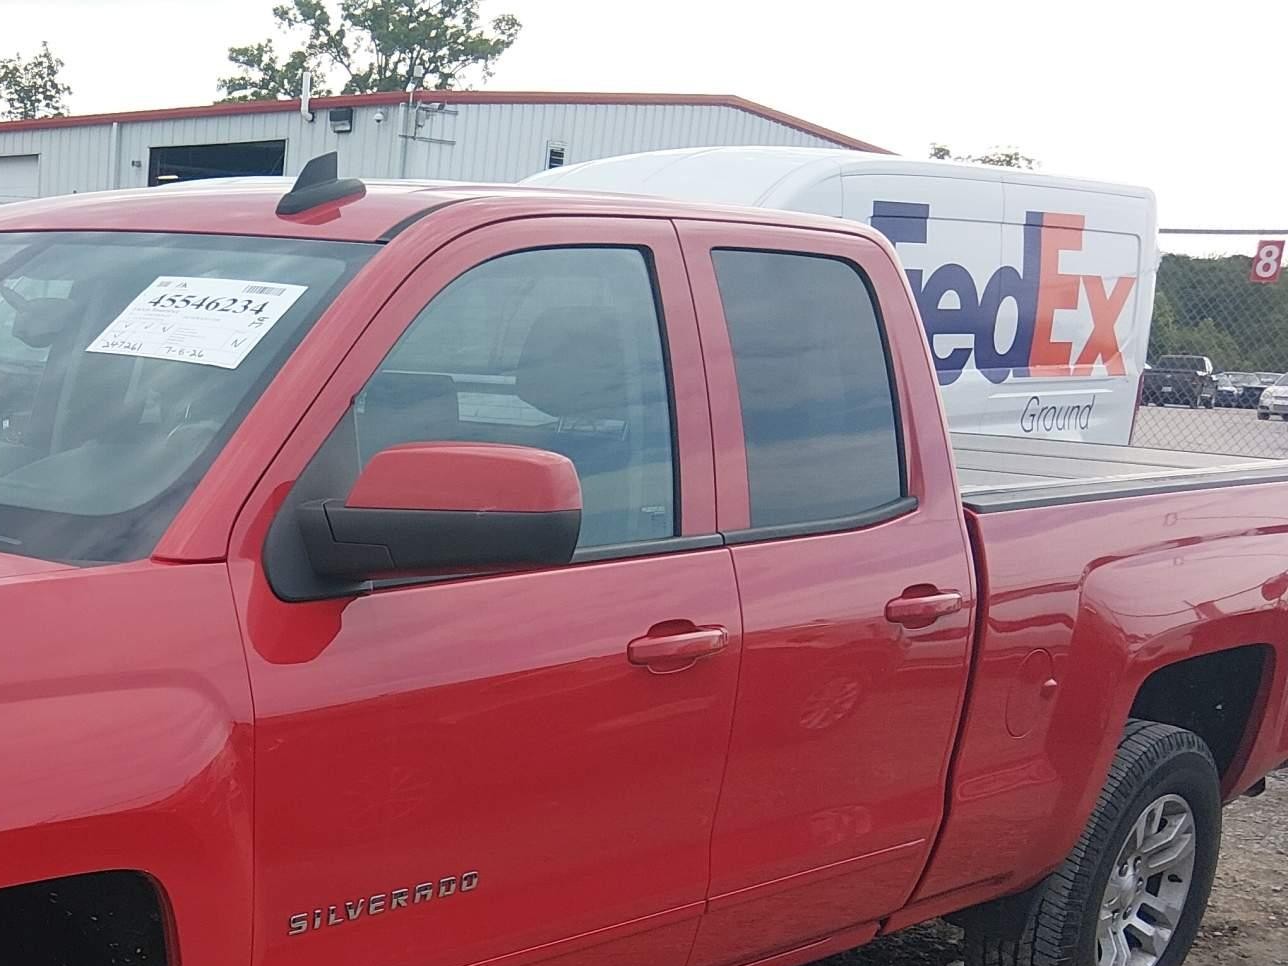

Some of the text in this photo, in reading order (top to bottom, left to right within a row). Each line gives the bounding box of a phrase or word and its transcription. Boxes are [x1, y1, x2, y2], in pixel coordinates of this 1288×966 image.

[1255, 244, 1280, 279] 8
[148, 292, 270, 316] 45546234
[1020, 395, 1096, 433] Ground
[288, 871, 478, 935] SILVERADO
